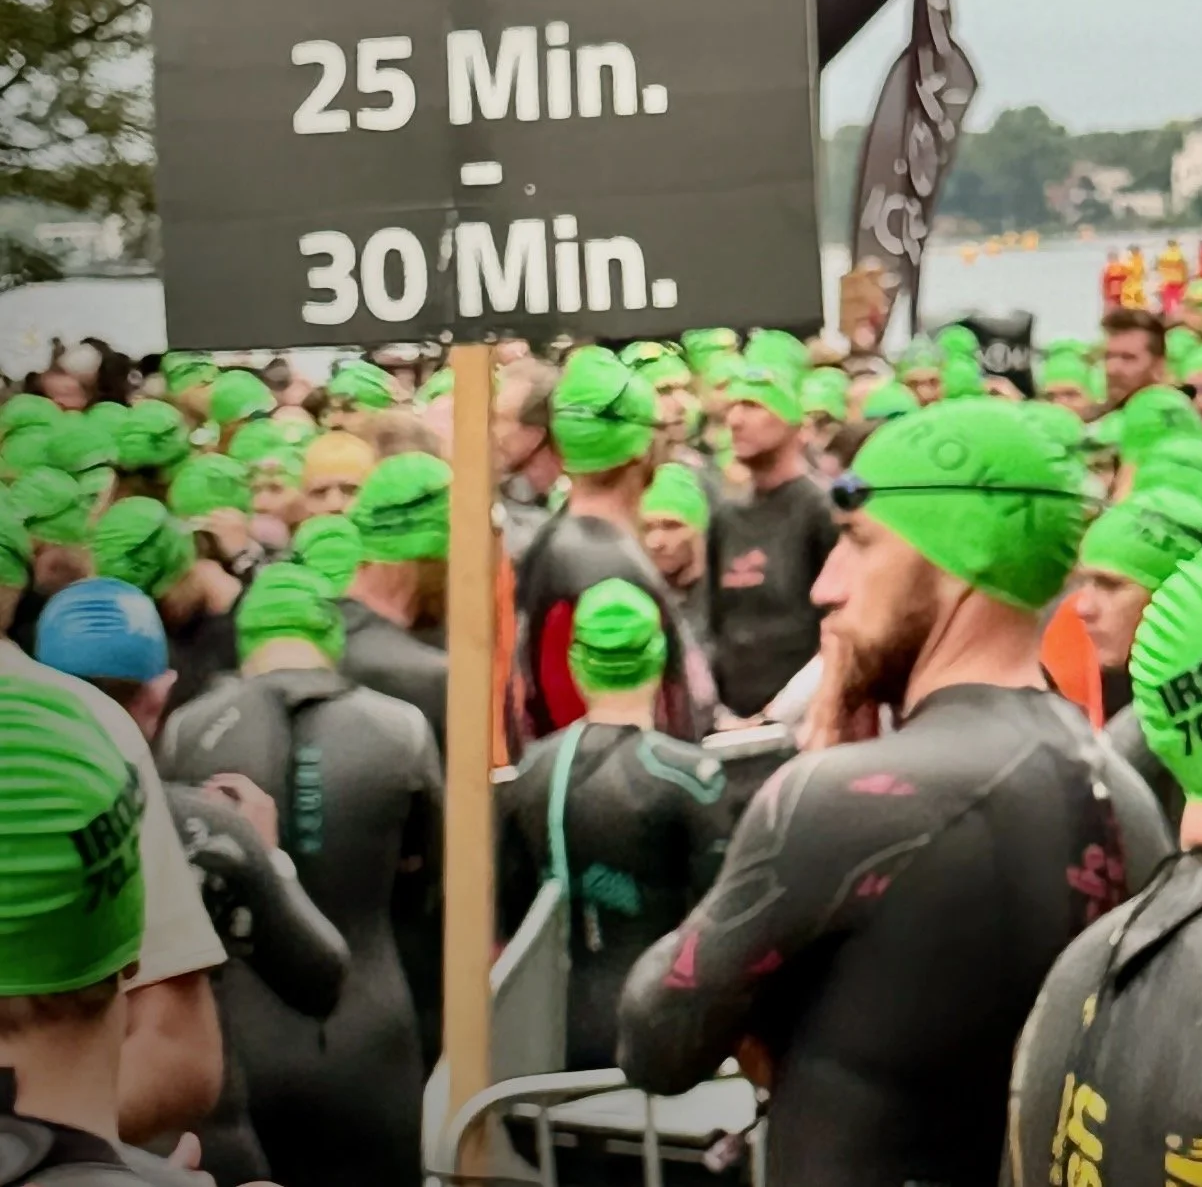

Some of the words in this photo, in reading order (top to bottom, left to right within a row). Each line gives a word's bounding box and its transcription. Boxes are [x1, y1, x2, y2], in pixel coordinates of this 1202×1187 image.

[290, 35, 417, 134] 25
[446, 20, 669, 126] Min.
[299, 226, 428, 325] 30
[455, 214, 678, 318] Min.
